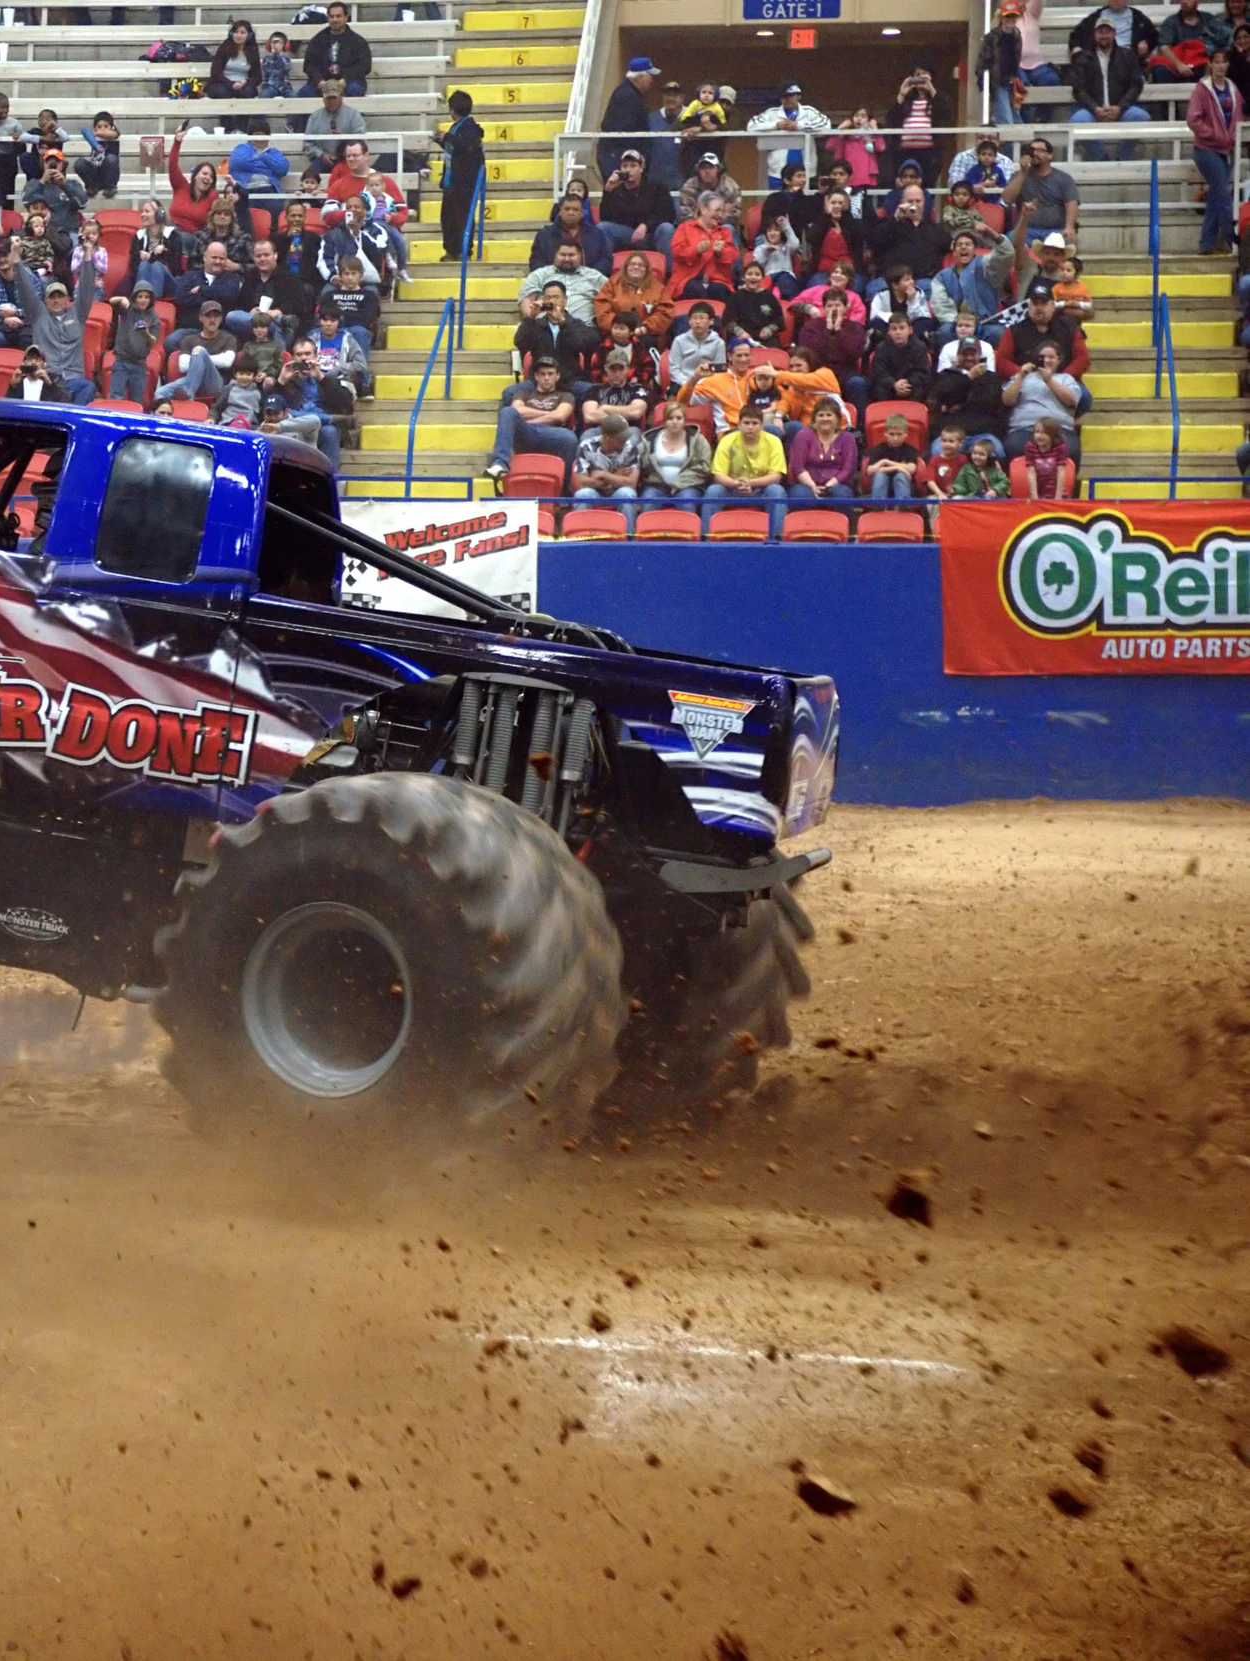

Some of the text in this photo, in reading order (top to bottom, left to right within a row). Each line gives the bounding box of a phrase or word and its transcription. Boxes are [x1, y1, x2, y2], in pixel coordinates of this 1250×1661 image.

[762, 3, 822, 18] GATE-1
[523, 17, 530, 28] 7
[517, 54, 524, 65] 6
[508, 90, 515, 102] 5
[500, 128, 507, 140] 4
[494, 167, 500, 179] 3
[384, 511, 507, 551] Welcome
[454, 525, 530, 564] Fans!
[1101, 637, 1250, 659] AUTO PARTS
[671, 708, 744, 734] MONSTER
[49, 686, 253, 783] DONE
[688, 725, 724, 743] JAM
[41, 922, 69, 934] TRUCK
